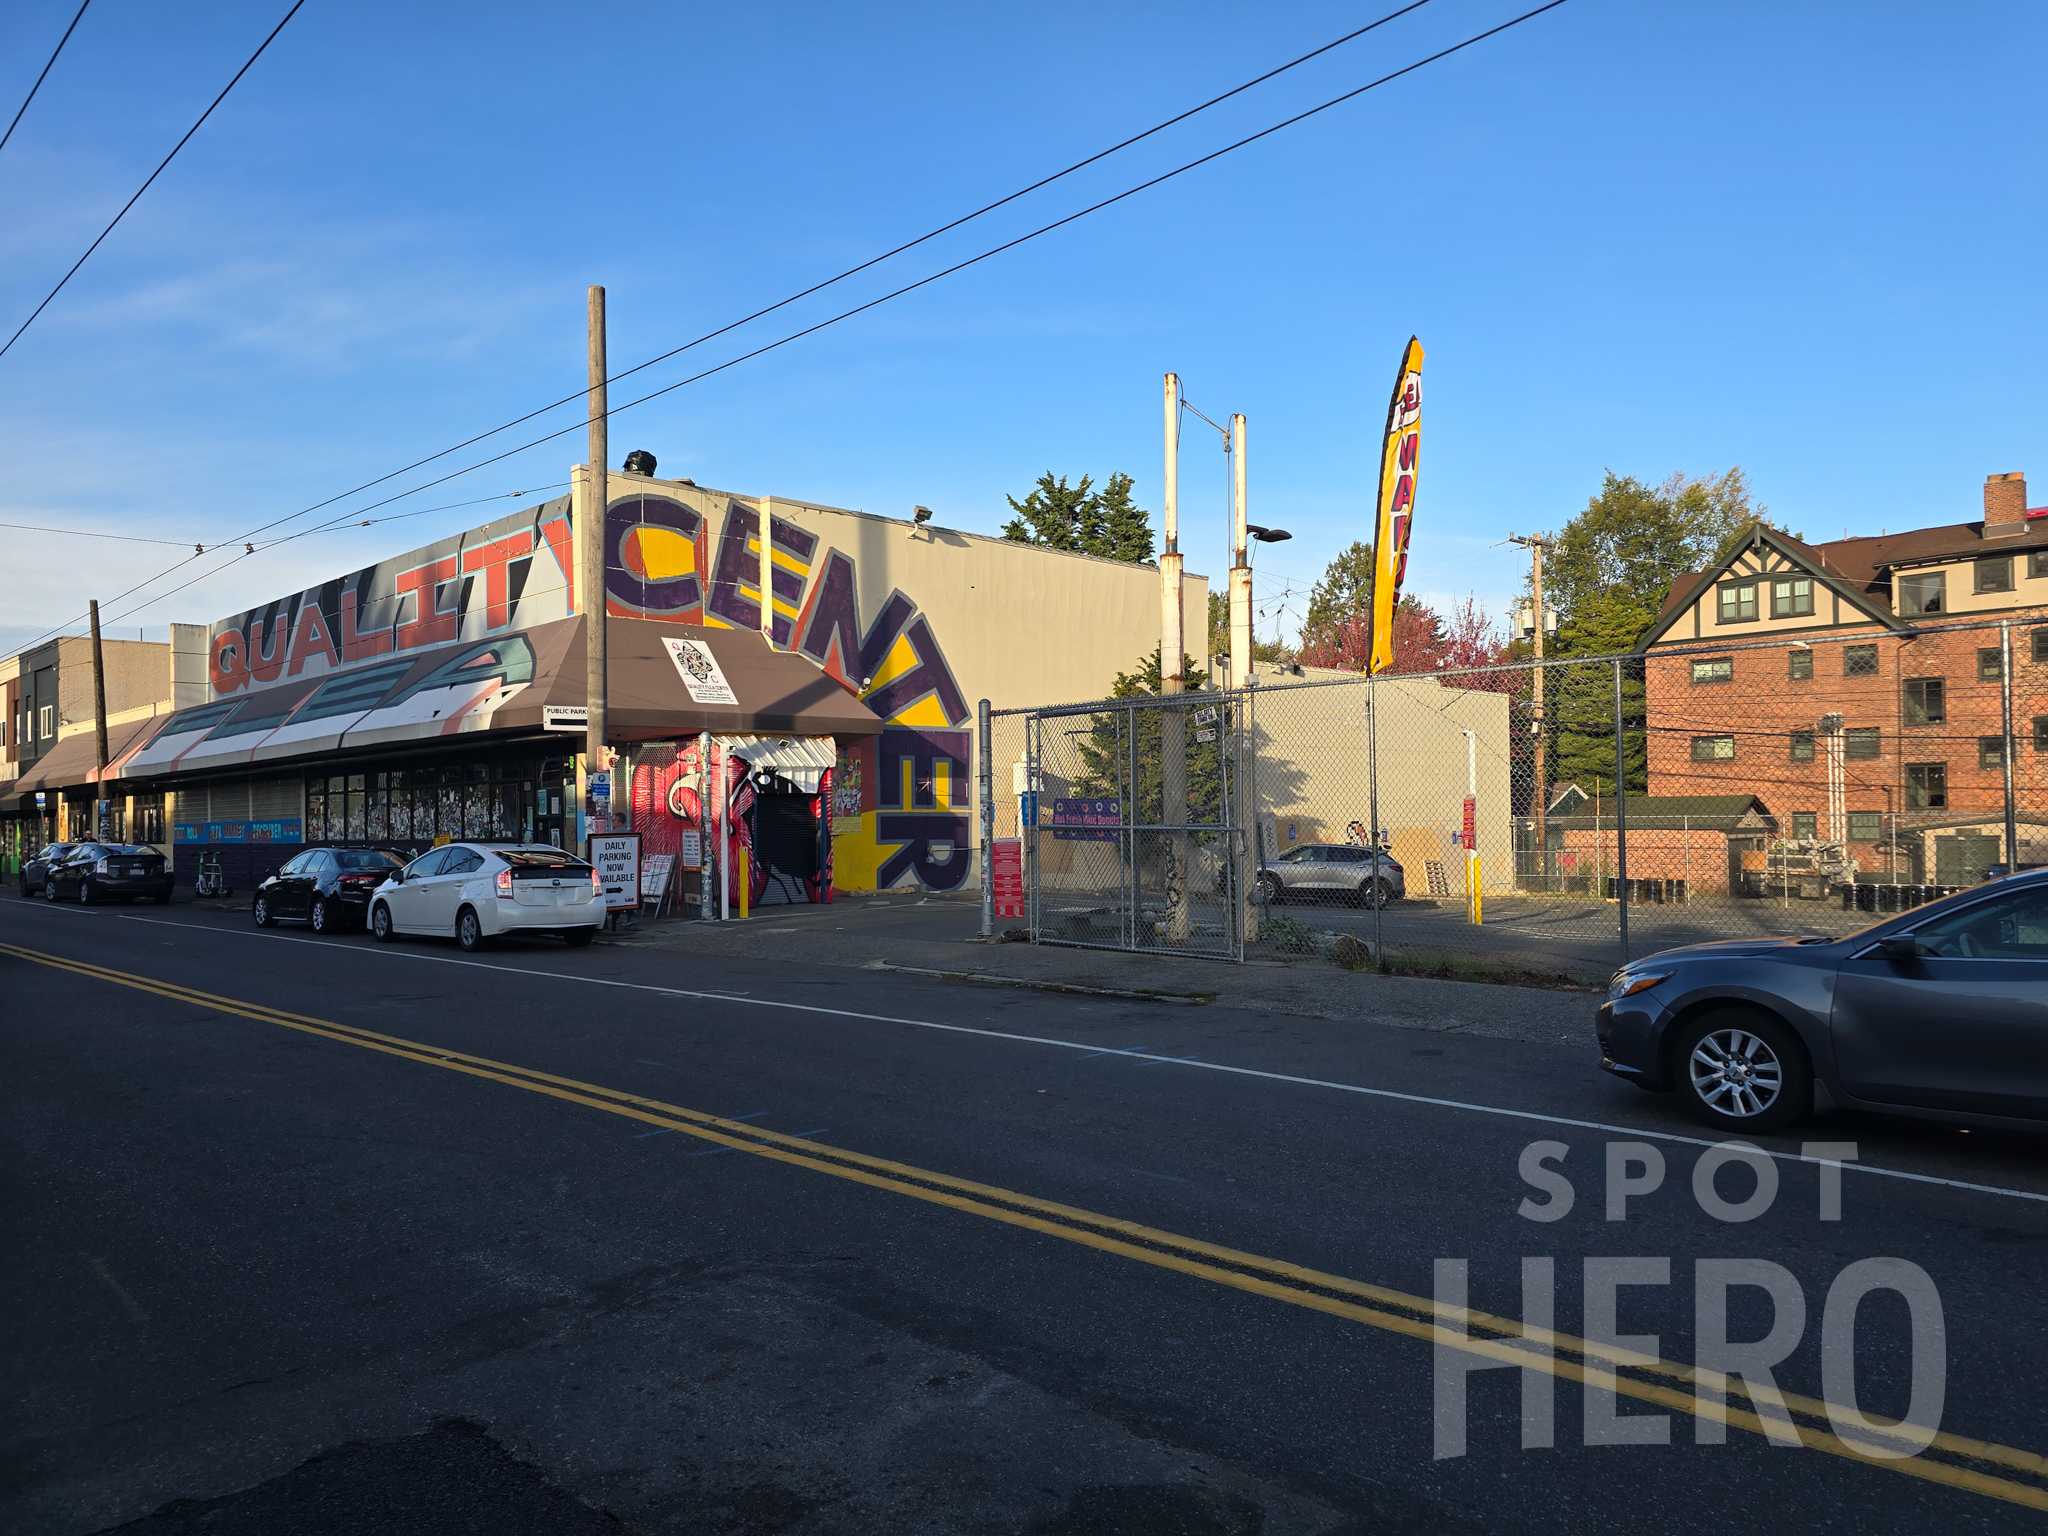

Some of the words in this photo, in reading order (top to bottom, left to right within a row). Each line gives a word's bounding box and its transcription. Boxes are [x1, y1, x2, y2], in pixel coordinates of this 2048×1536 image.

[606, 493, 973, 891] CENTER
[605, 842, 626, 850] DAILY
[600, 852, 632, 862] PARKING
[606, 864, 624, 872] NOW
[600, 873, 635, 883] VAILABLE
